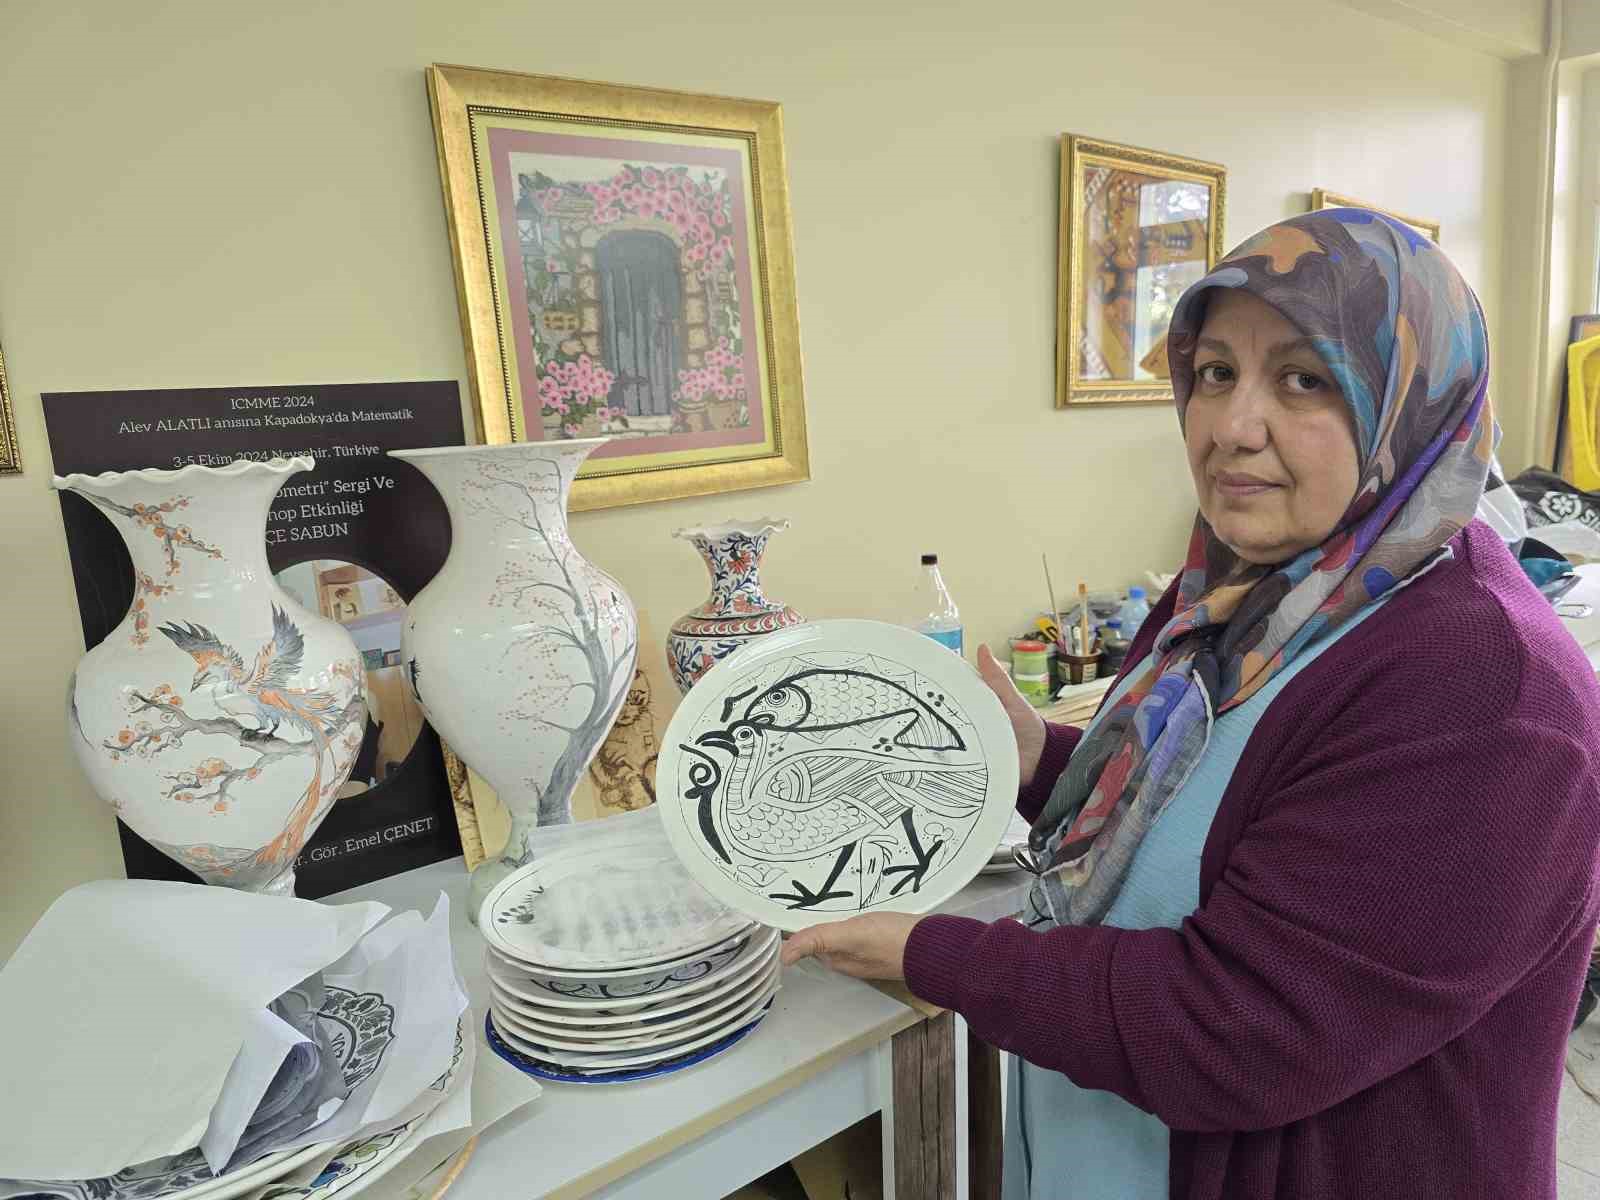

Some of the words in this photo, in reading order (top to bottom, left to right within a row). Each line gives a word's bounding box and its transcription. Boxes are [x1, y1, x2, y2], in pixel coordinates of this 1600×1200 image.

[230, 397, 280, 410] ICMME
[284, 396, 315, 408] 2024
[119, 421, 152, 434] Alev
[155, 417, 212, 432] ALATLI
[264, 411, 349, 427] Kapadokya'da
[351, 408, 414, 422] Matematik
[199, 453, 233, 466] Ekim
[333, 444, 380, 458] Türkiye
[333, 478, 371, 494] Sergi
[373, 475, 395, 489] Ve
[300, 500, 364, 517] Etkinliği
[289, 522, 349, 541] SABUN
[310, 846, 343, 861] Gör.
[344, 831, 381, 853] Emel
[383, 816, 433, 843] ÇENET
